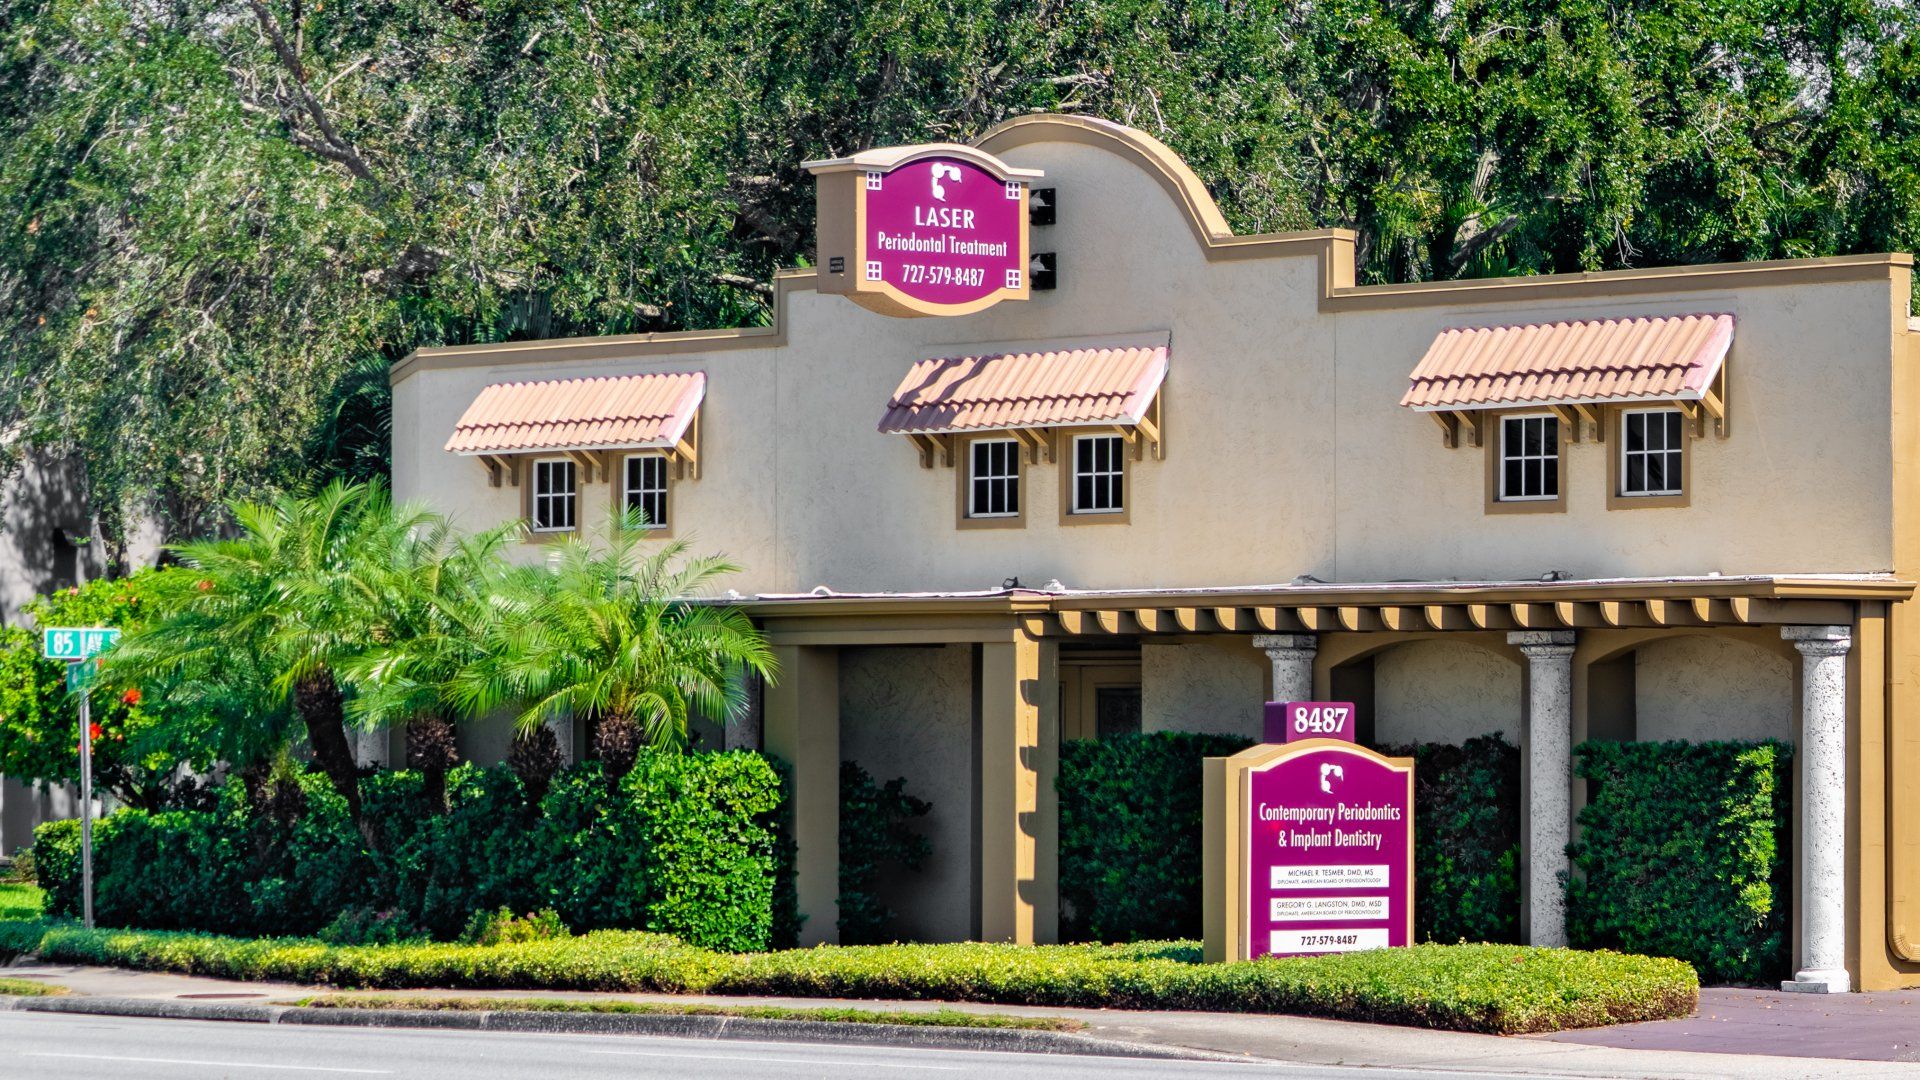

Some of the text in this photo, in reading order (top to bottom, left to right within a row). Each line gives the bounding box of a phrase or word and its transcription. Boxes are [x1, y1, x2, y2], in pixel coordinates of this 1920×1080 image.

[915, 206, 975, 229] LASER
[878, 231, 1007, 257] Periodontal Treatment
[902, 264, 985, 287] 727-579-8487
[53, 632, 74, 655] 85
[1294, 707, 1349, 733] 8487
[1259, 801, 1400, 825] Contemporary Periodontics
[1278, 828, 1382, 850] & Implant Dentistry
[1288, 869, 1314, 877] MICHAEL
[1322, 869, 1346, 878] TESMER,
[1347, 868, 1363, 876] DMD,
[1364, 868, 1374, 876] MS
[1276, 901, 1306, 909] GREGORY
[1314, 900, 1350, 909] LANGSTON,
[1351, 900, 1368, 909] DMD,
[1300, 935, 1358, 946] 727-579-8487
